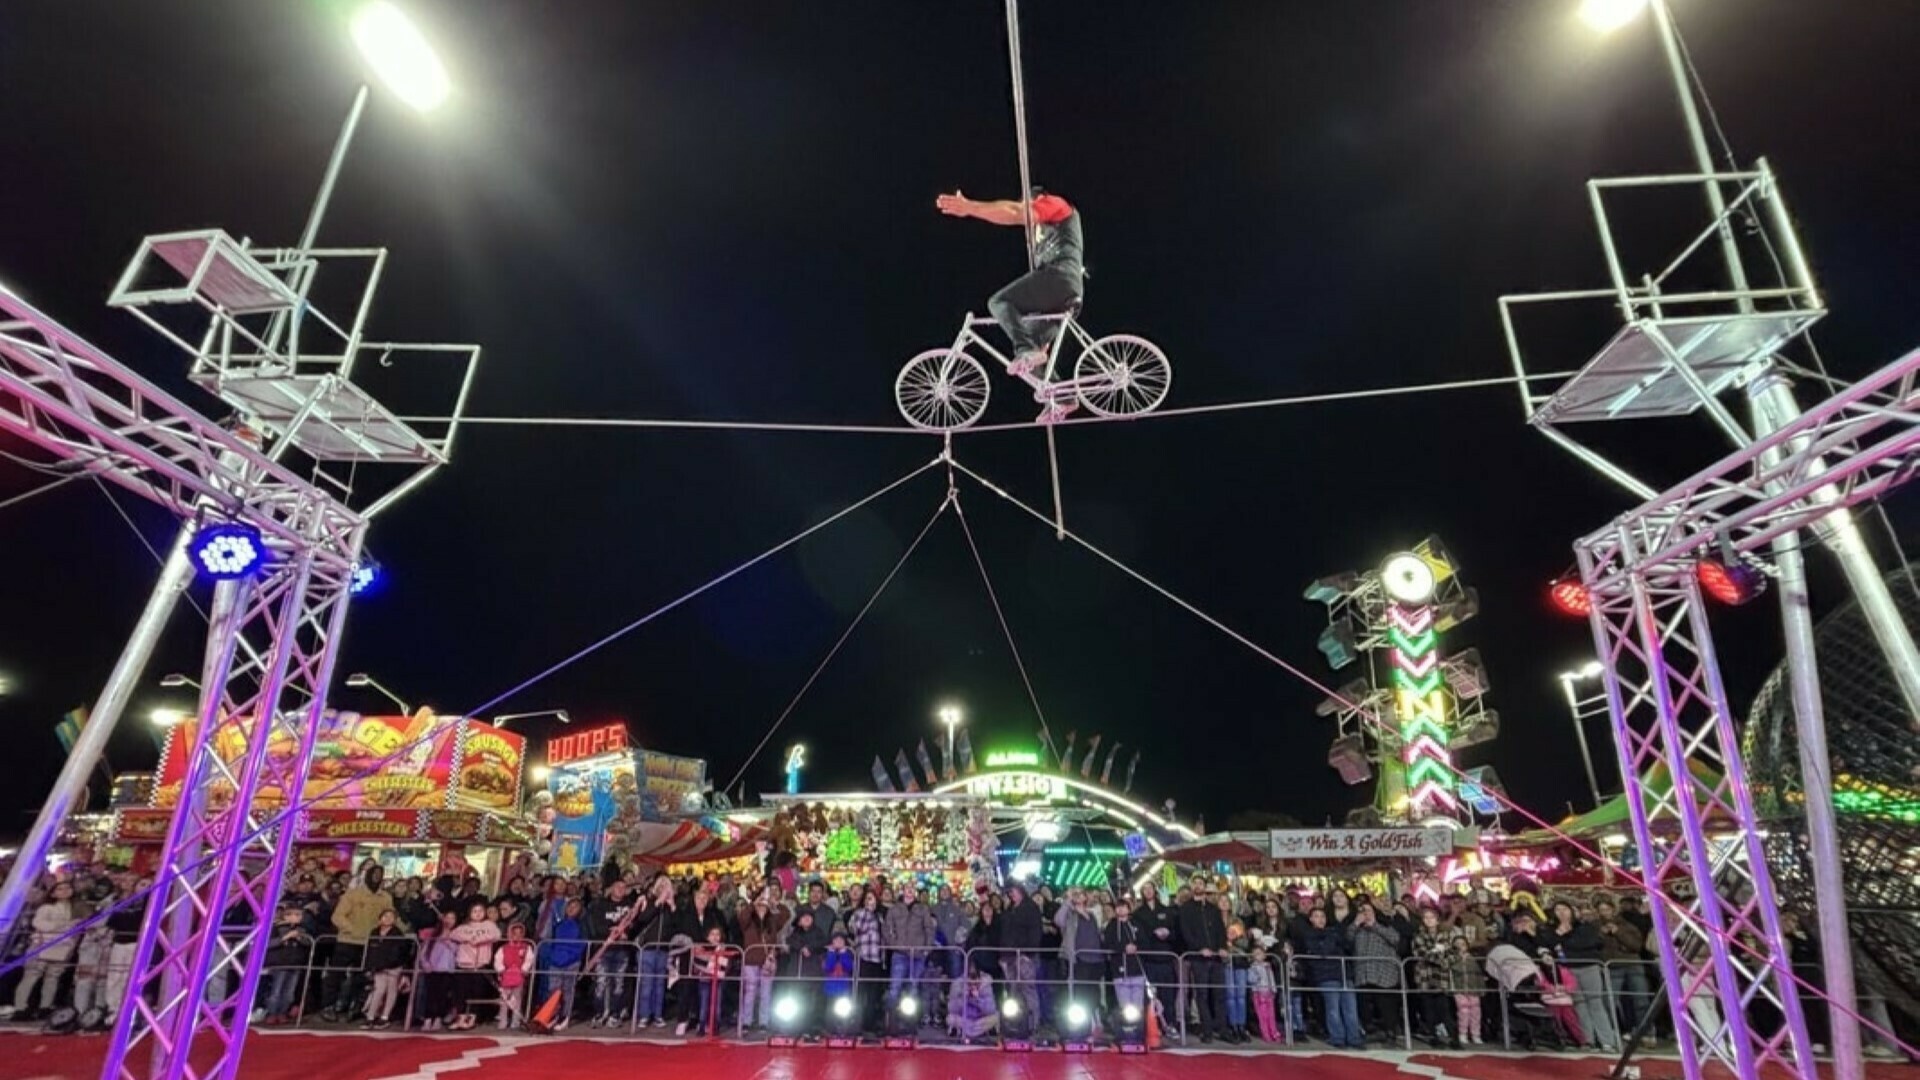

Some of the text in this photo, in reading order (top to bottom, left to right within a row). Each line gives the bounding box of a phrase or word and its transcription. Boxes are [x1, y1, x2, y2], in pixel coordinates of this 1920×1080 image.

[548, 725, 625, 764] HOOPS
[1307, 833, 1338, 850] Win
[1342, 834, 1355, 850] A
